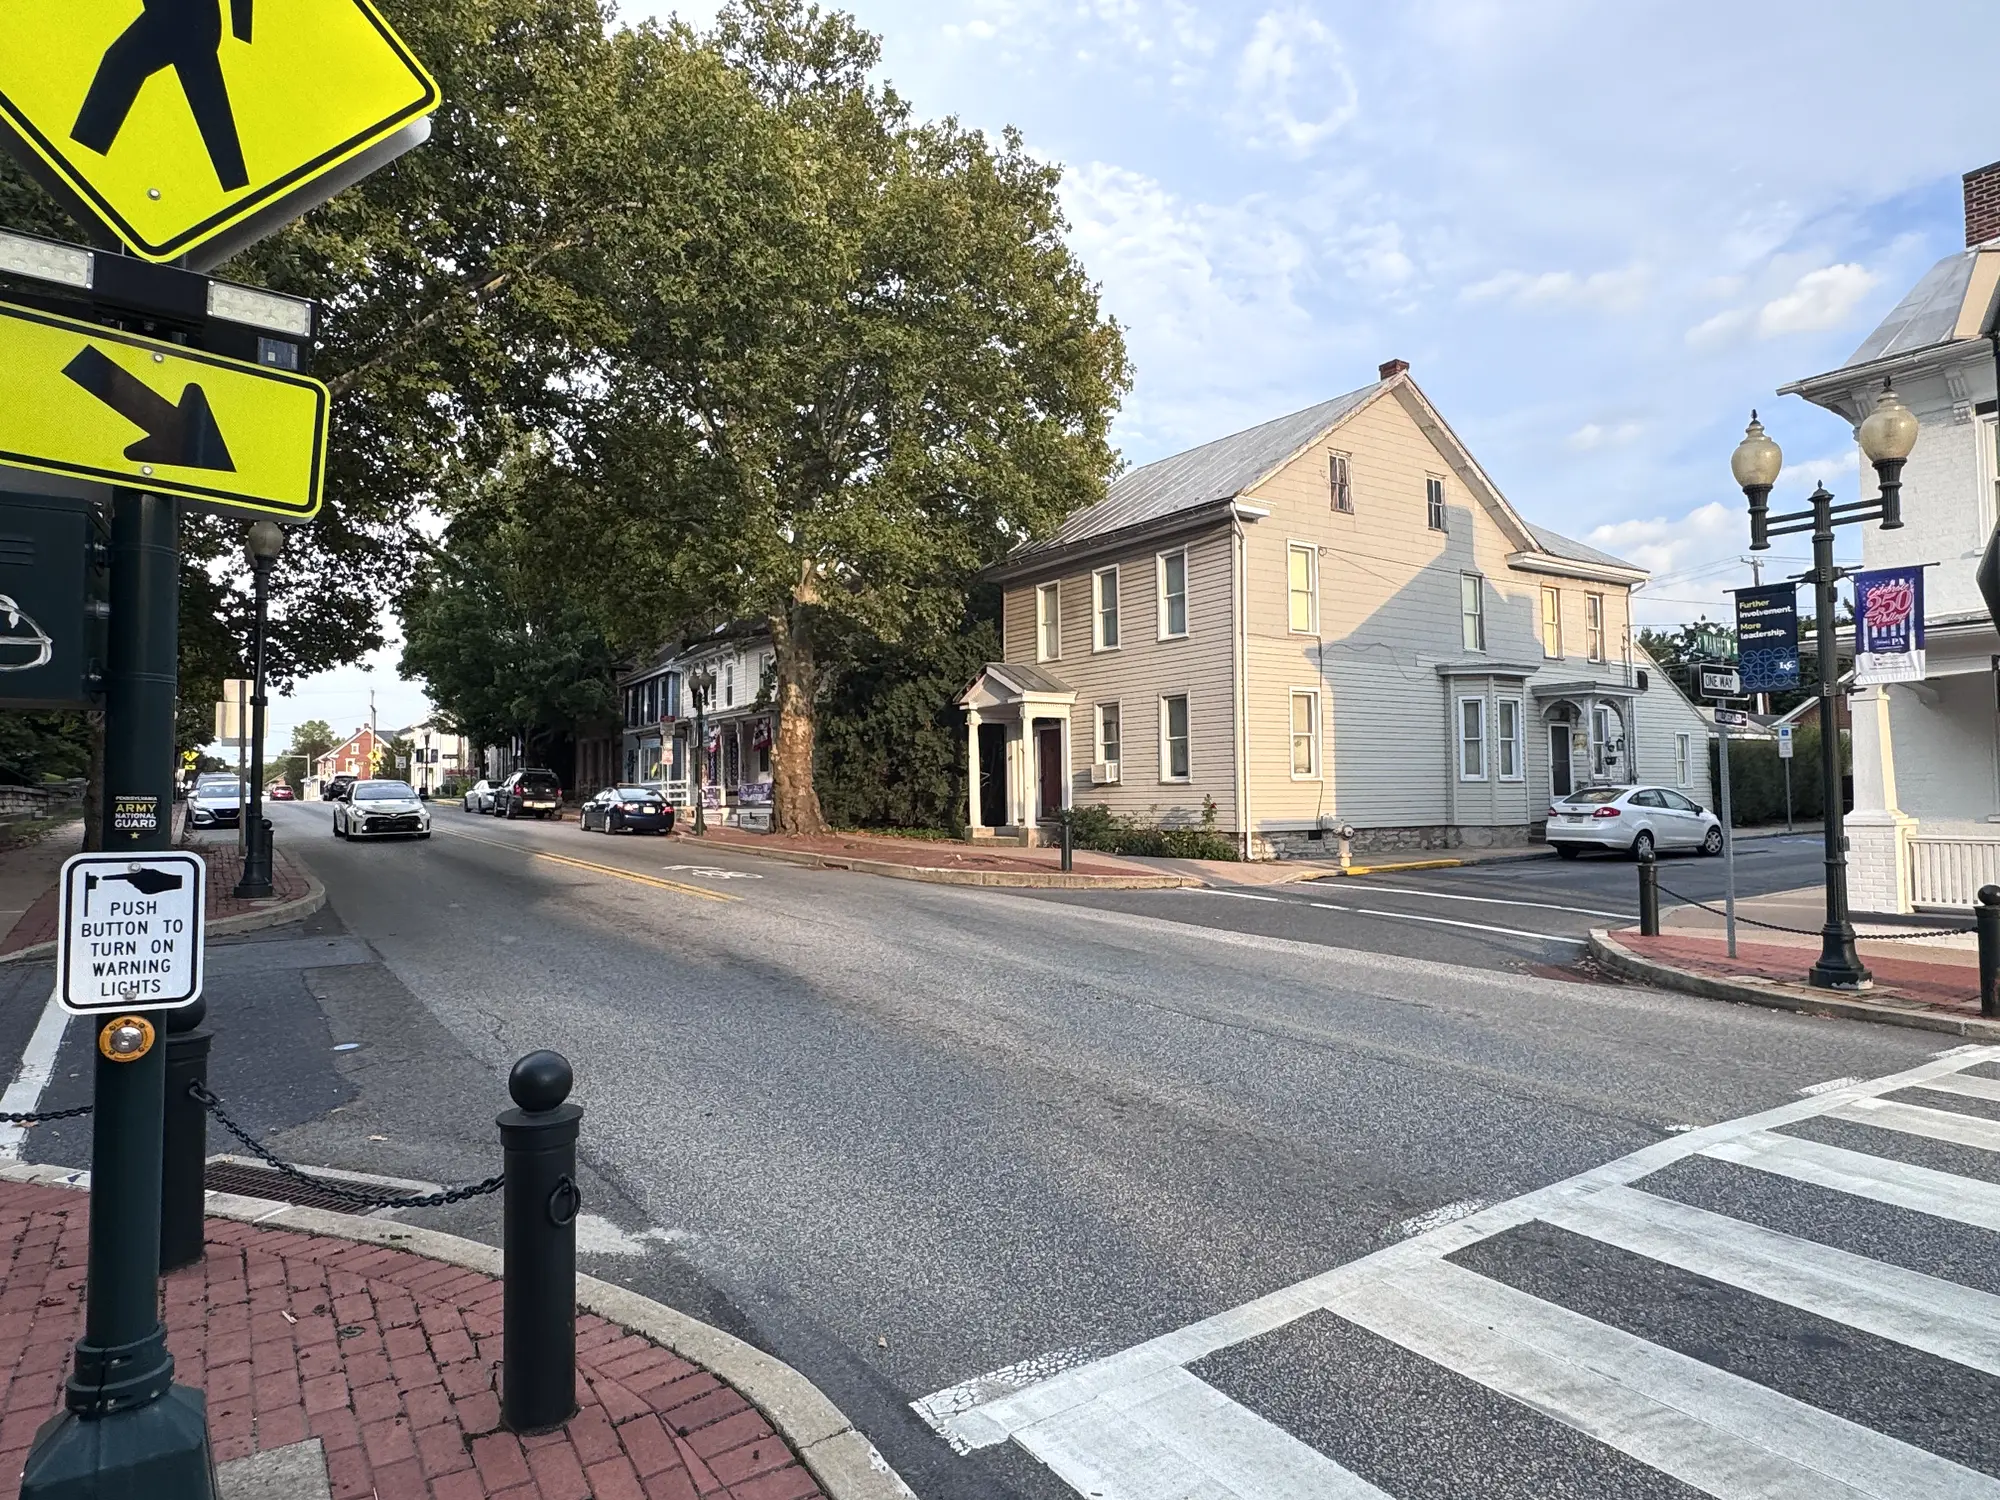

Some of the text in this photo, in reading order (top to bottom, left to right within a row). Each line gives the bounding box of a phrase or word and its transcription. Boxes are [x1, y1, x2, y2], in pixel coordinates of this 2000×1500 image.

[1739, 600, 1770, 610] Further
[1864, 589, 1913, 618] 250
[1740, 605, 1794, 618] involvement.
[1740, 622, 1761, 631] More
[1741, 628, 1787, 640] leadership.
[1891, 637, 1905, 646] PA
[1705, 674, 1734, 689] ONE WAY
[115, 803, 157, 812] ARMY
[114, 819, 157, 828] GUARD
[110, 900, 157, 917] PUSH
[81, 918, 183, 938] BUTTON TO
[90, 939, 174, 957] TURN ON
[92, 959, 171, 977] WARNING
[101, 979, 161, 997] LIGHTS
